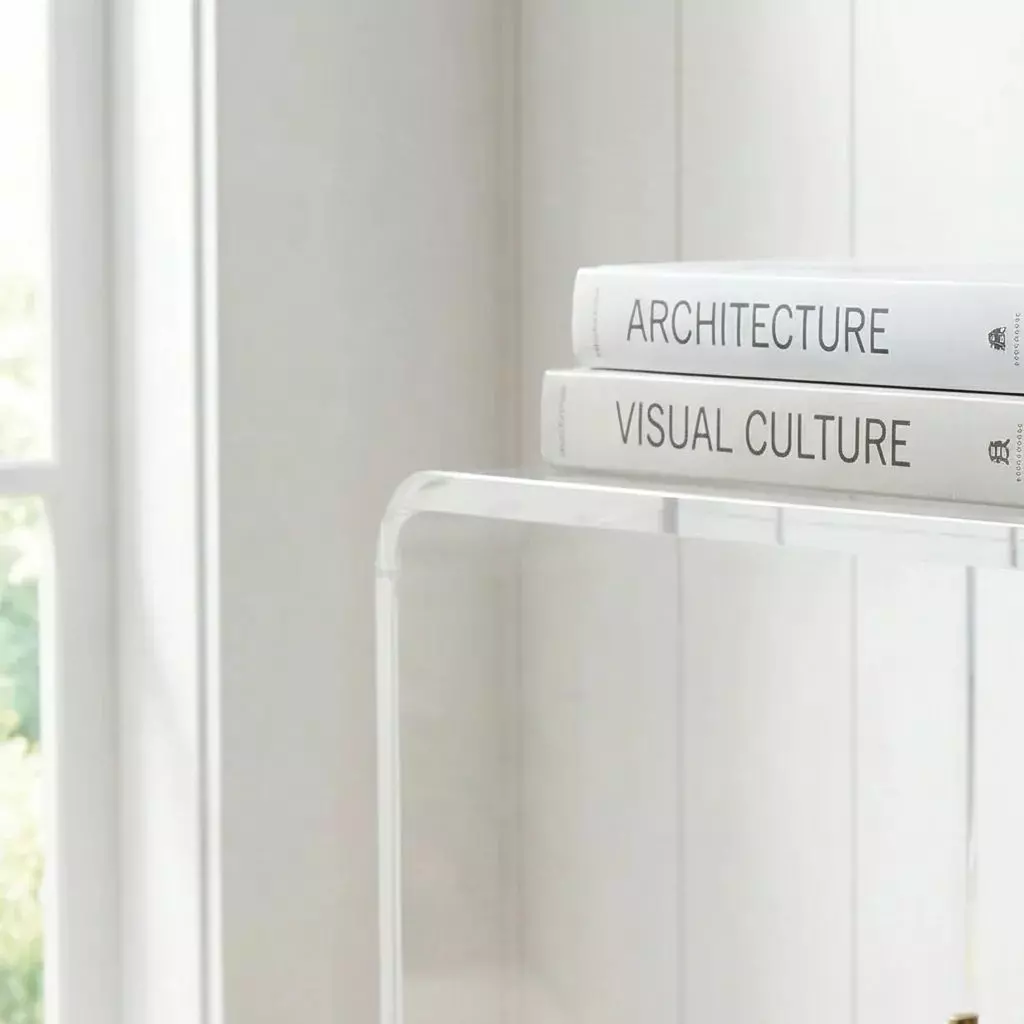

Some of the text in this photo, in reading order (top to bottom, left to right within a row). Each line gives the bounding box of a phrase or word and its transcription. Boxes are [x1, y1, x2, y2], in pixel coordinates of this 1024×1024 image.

[626, 299, 889, 355] ARCHITECTURE
[615, 401, 733, 454] VISUAL
[745, 408, 911, 468] CULTURE
